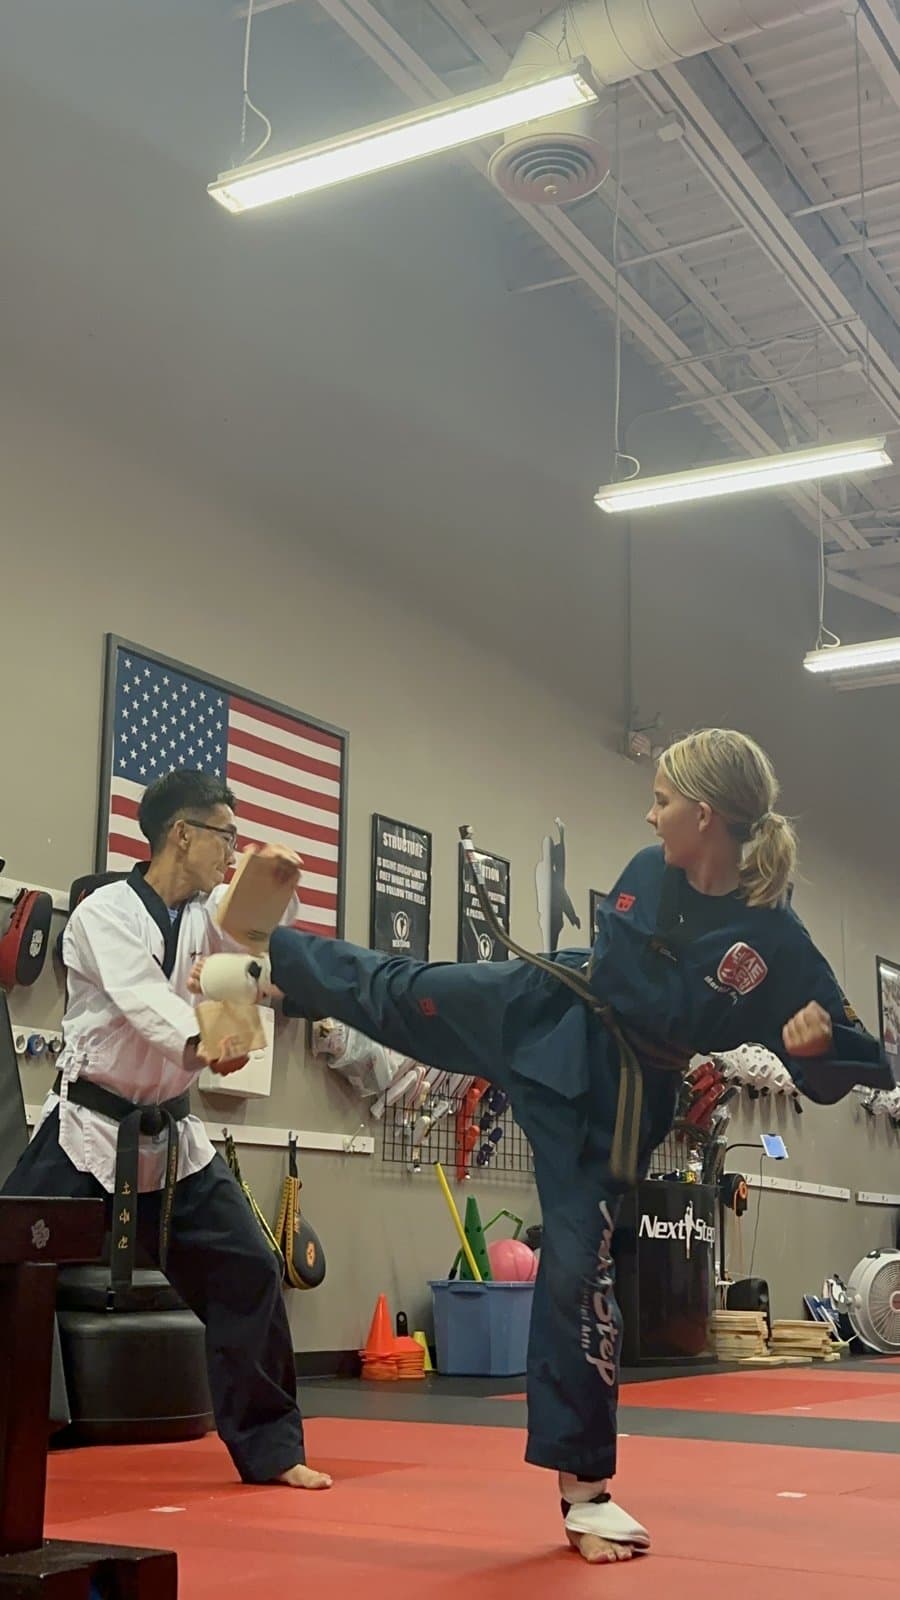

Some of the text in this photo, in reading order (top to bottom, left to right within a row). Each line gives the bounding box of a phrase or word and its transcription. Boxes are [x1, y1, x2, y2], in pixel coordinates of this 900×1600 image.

[383, 832, 423, 858] STRUCTURE
[638, 1214, 716, 1248] Next Step
